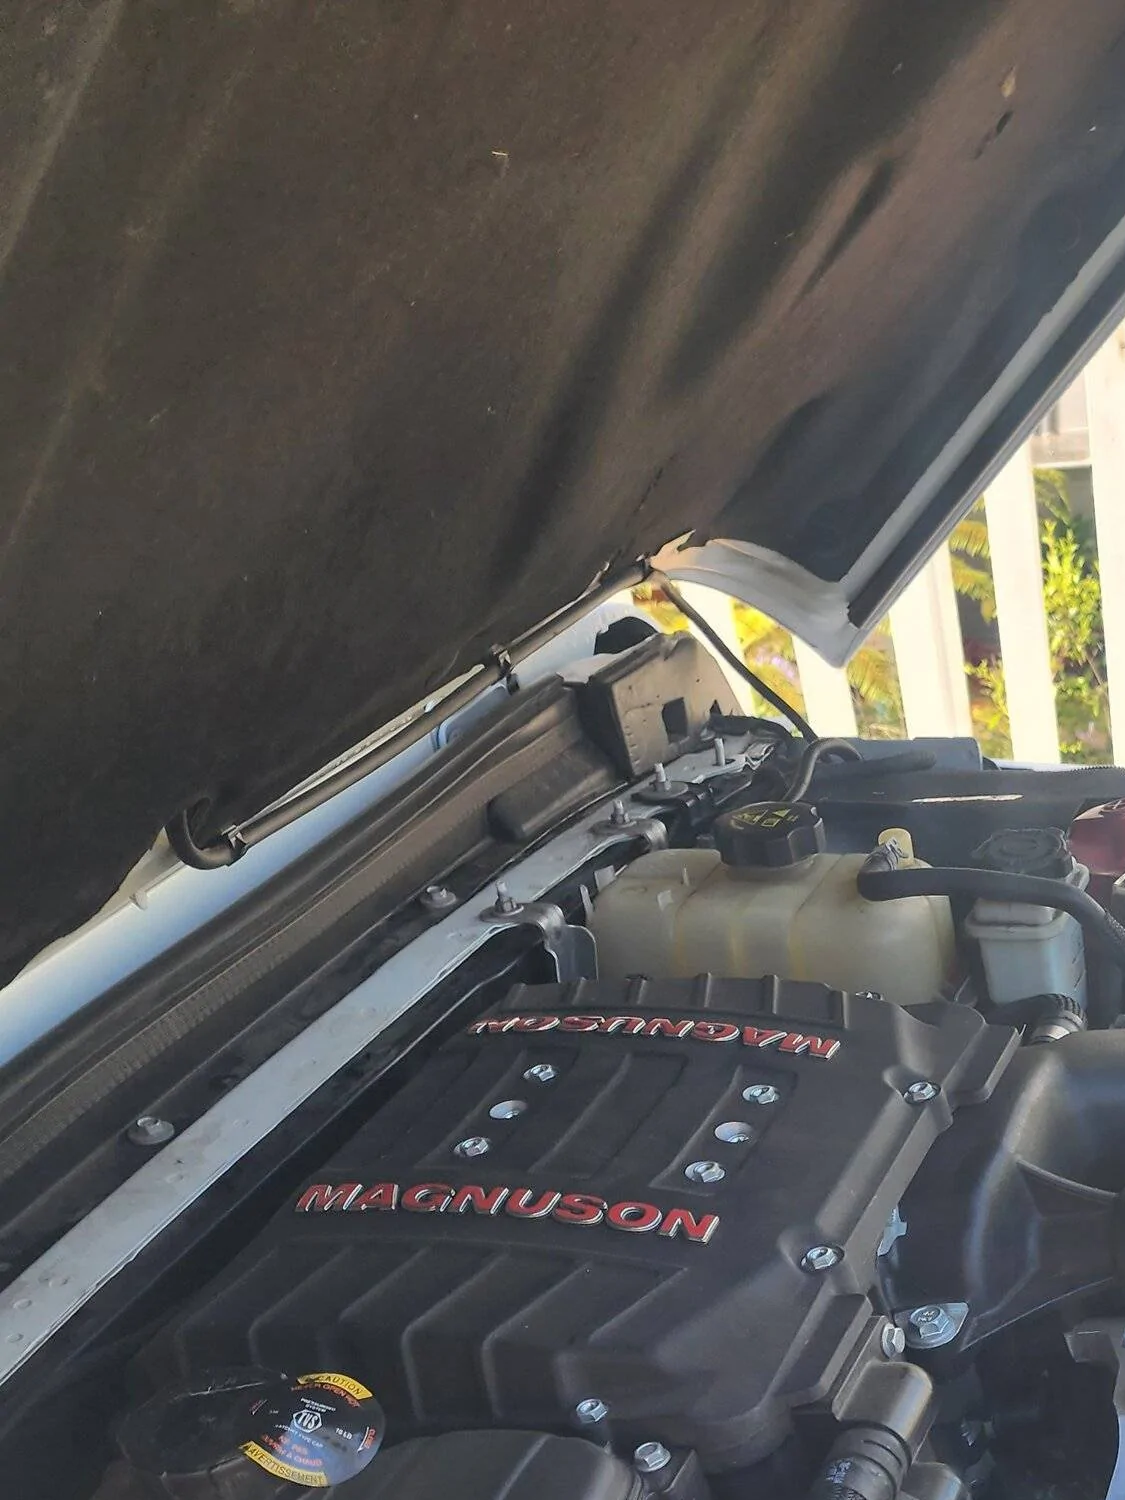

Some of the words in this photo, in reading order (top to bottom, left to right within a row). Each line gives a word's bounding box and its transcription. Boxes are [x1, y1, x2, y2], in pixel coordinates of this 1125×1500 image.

[467, 1014, 843, 1060] MAGNUSON
[295, 1182, 720, 1245] MAGNUSON
[316, 1375, 362, 1396] CAUTION
[297, 1412, 319, 1430] TVS
